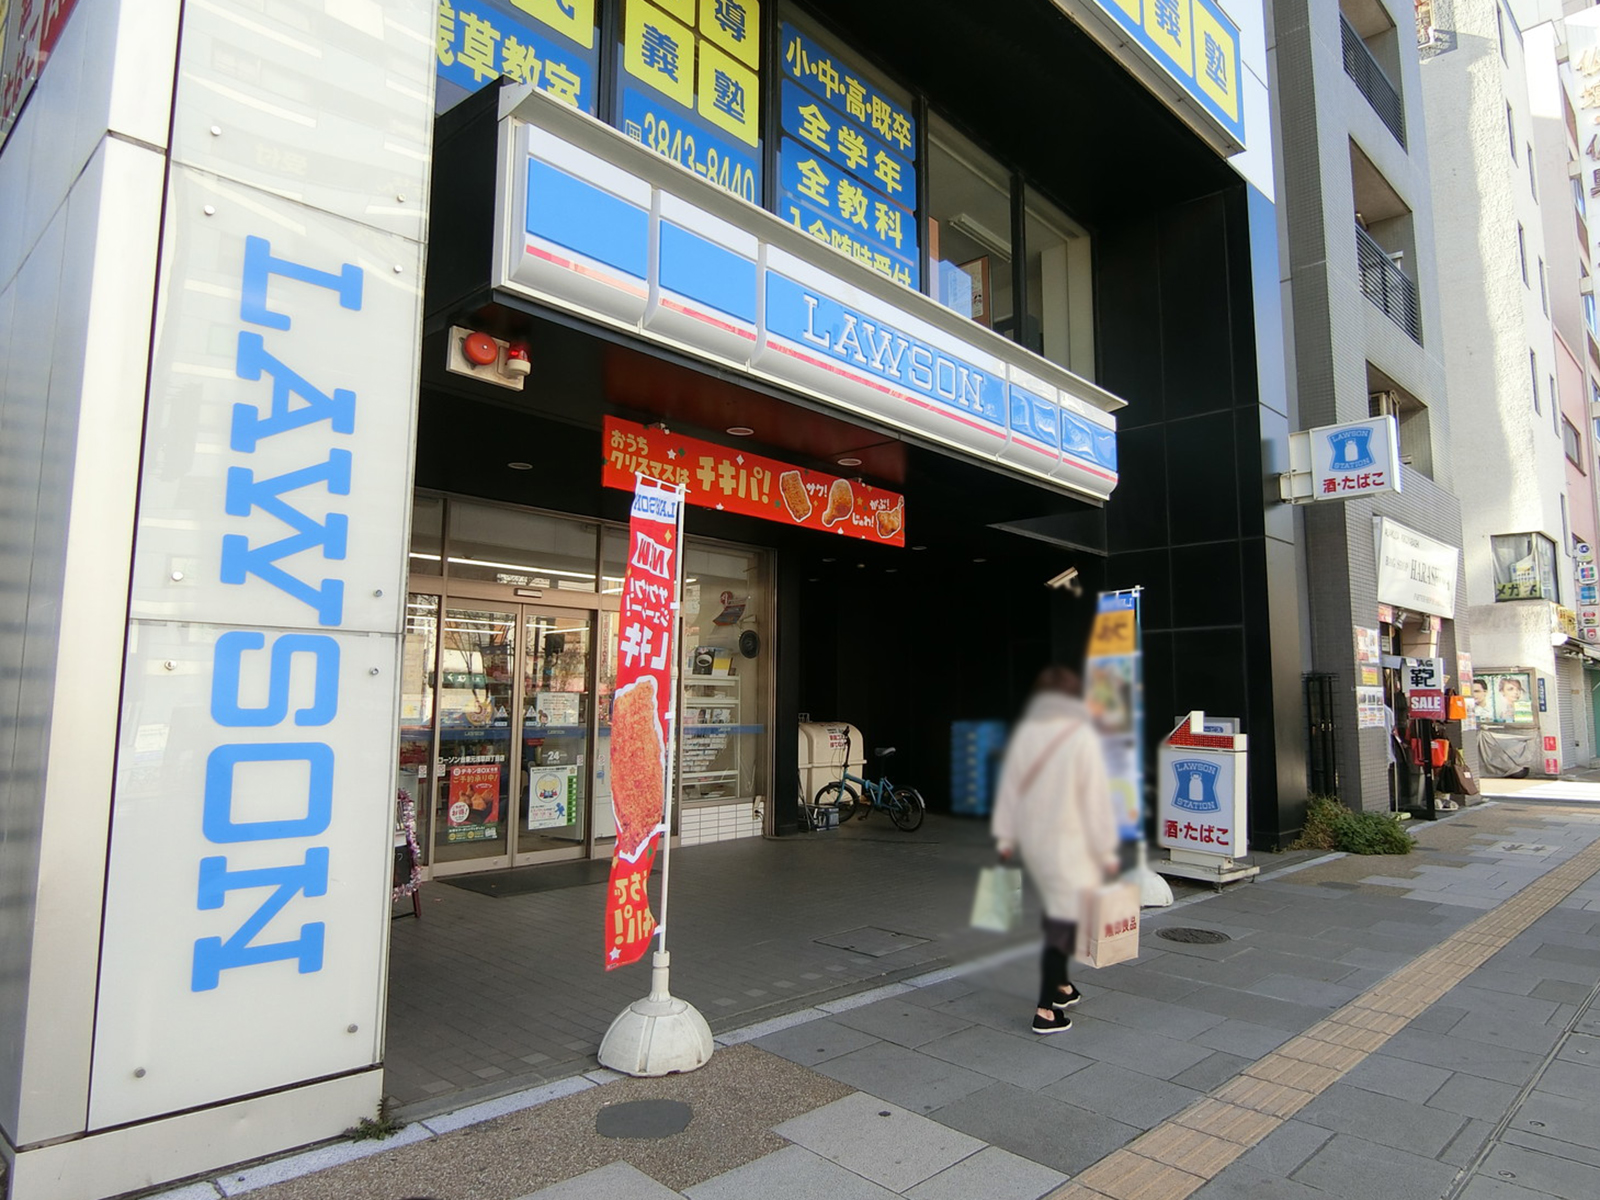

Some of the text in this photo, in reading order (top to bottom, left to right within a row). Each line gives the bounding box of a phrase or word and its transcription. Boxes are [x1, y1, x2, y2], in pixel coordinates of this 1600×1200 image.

[798, 103, 903, 194] 全学年
[797, 158, 903, 249] 全教科
[803, 292, 986, 414] LAWSON
[611, 430, 649, 456] おうち
[1331, 430, 1369, 443] LAWSON
[1333, 458, 1371, 470] STATION
[696, 456, 772, 504] チキパ!
[1323, 472, 1385, 494] 酒・たばこ
[191, 234, 364, 993] LAWSON
[1411, 696, 1441, 709] SALE
[547, 750, 560, 761] 24
[1176, 762, 1217, 775] LAWSON
[1176, 797, 1216, 810] STATION
[1164, 819, 1230, 847] 酒・たばこ
